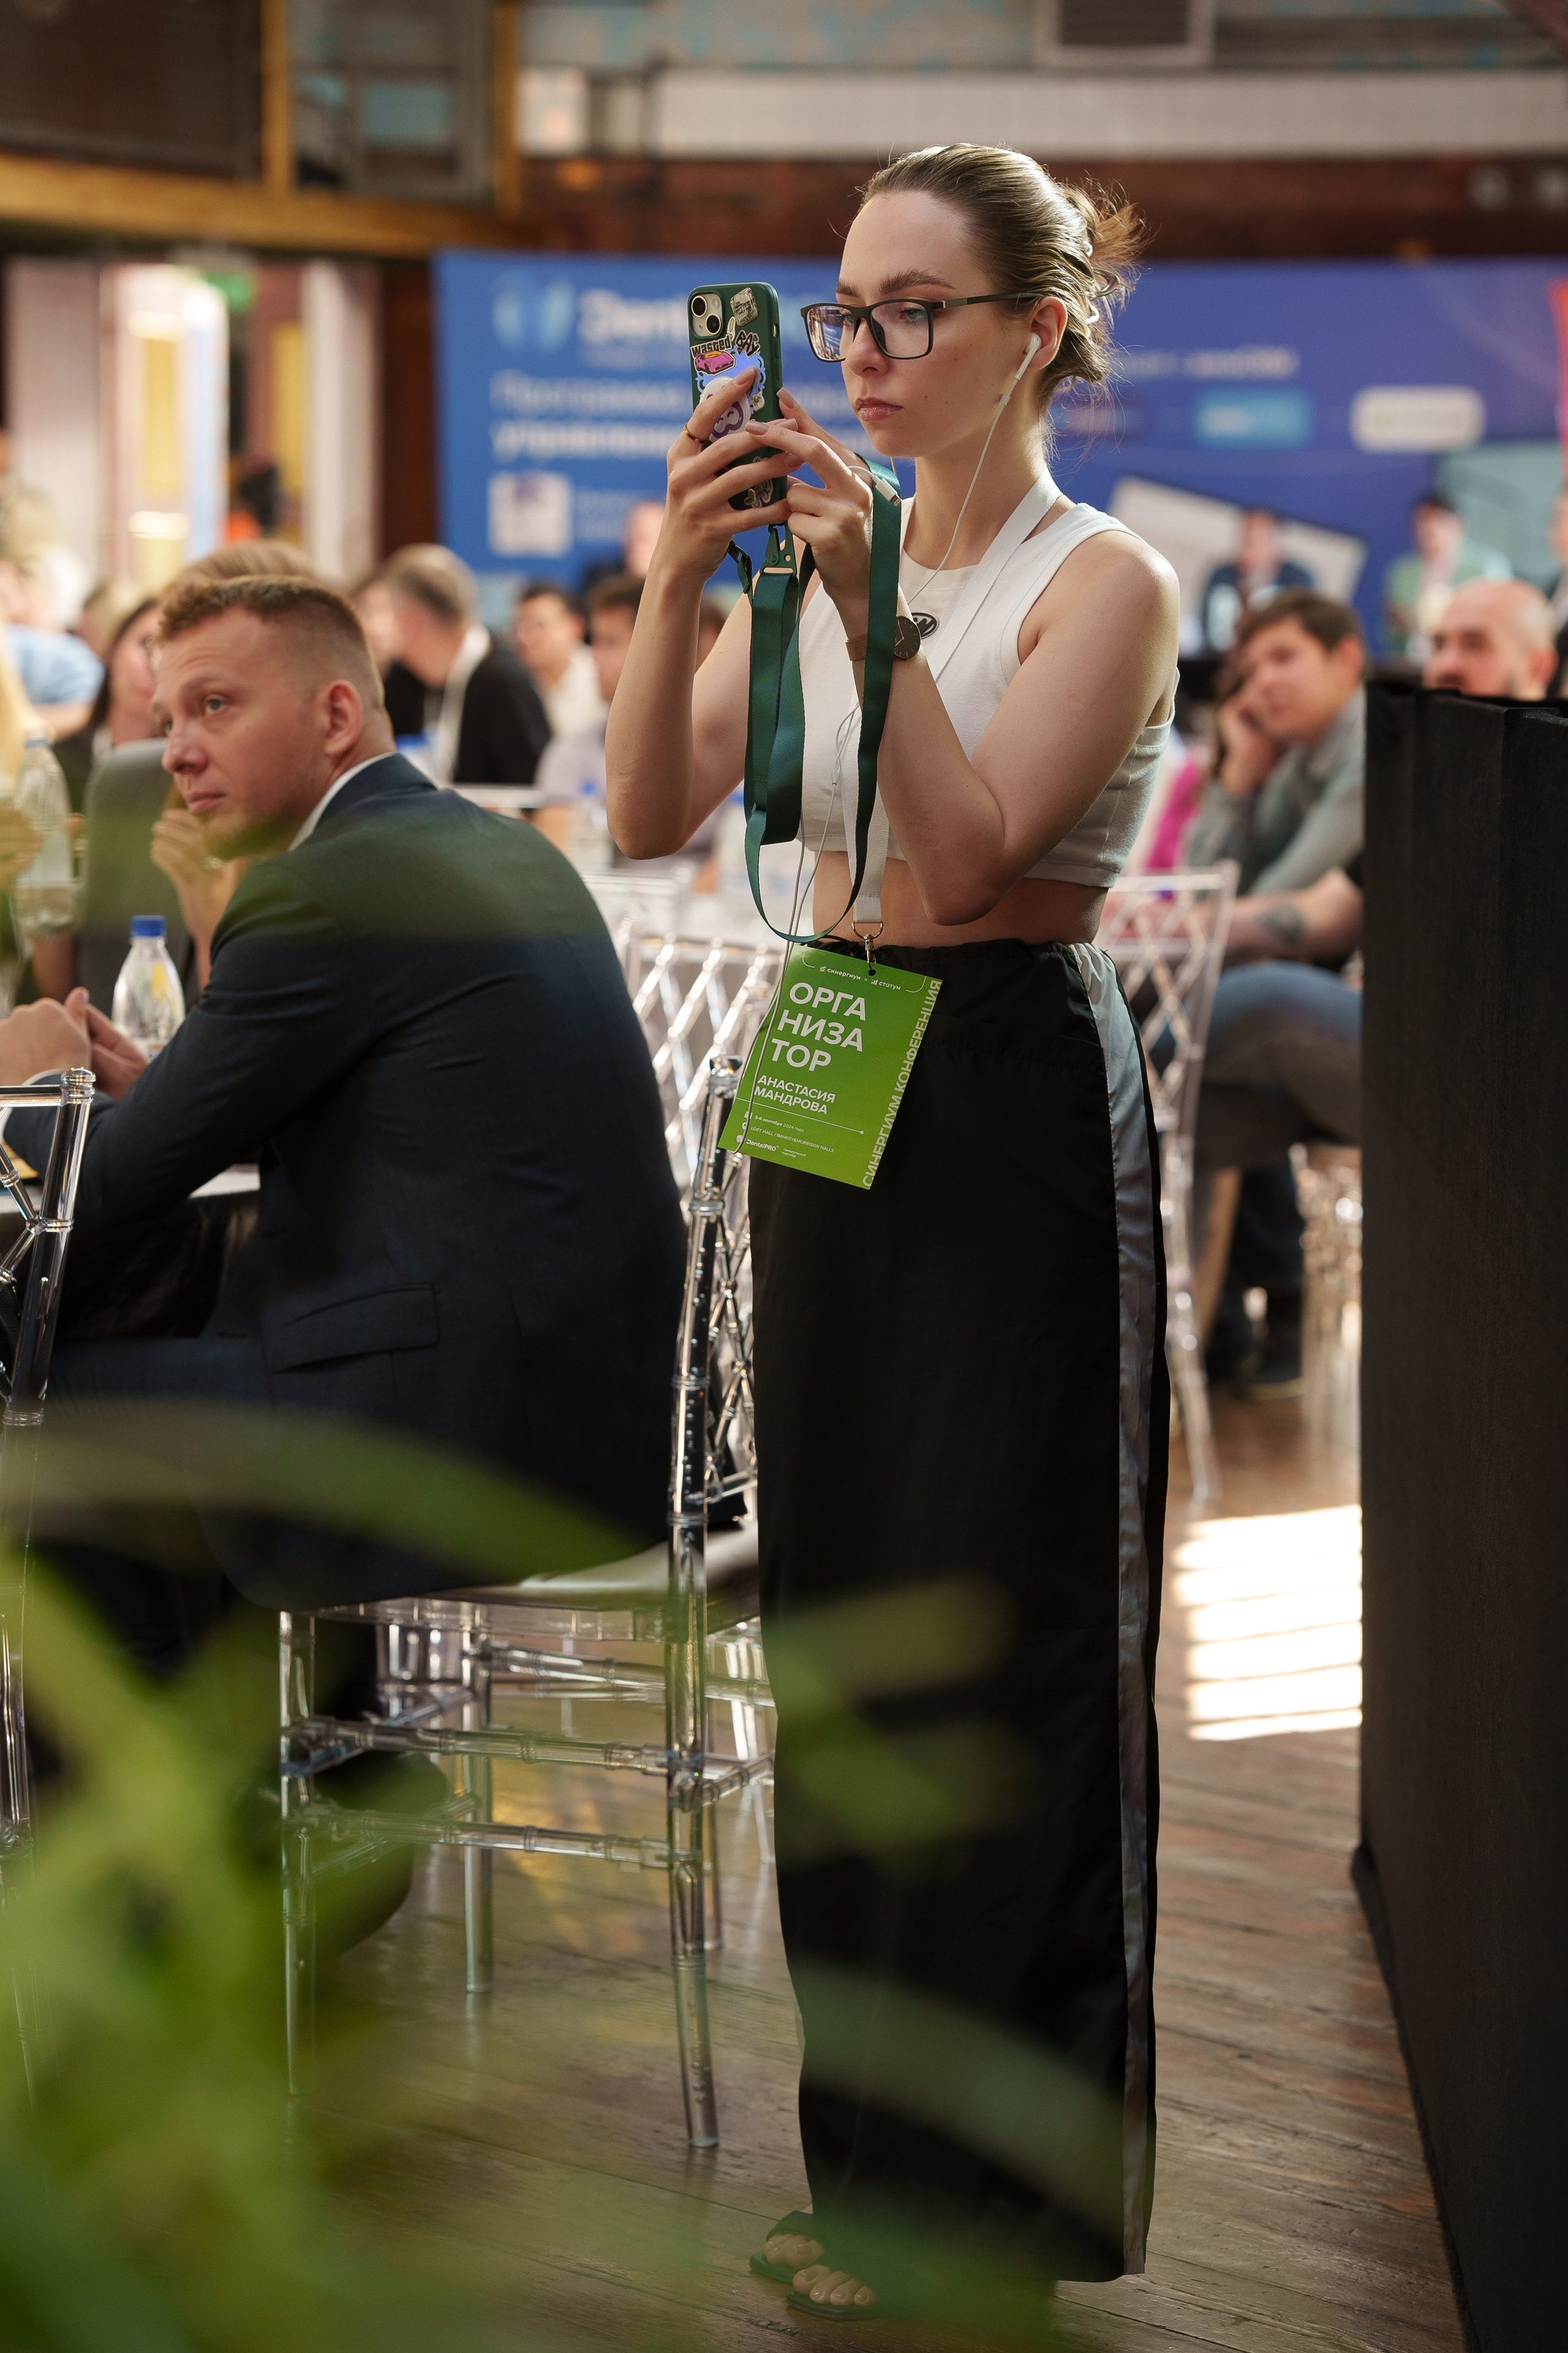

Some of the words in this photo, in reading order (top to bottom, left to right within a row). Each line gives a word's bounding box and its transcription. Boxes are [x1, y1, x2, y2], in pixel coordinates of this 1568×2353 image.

[827, 967, 861, 980] синергиум
[878, 981, 901, 990] статум
[790, 982, 866, 1021] ОРГА
[777, 1009, 862, 1052] НИЗА
[771, 1038, 831, 1071] ТОР
[757, 1075, 836, 1103] АНАСТАСИЯ
[862, 1095, 902, 1188] СИНЕРГИУМ
[894, 980, 942, 1093] КОНФЕРЕНЦИЯ
[754, 1086, 827, 1114] МАНДРОВА
[763, 1118, 783, 1127] сентября
[777, 1133, 820, 1149] BANKSY&MORRISON
